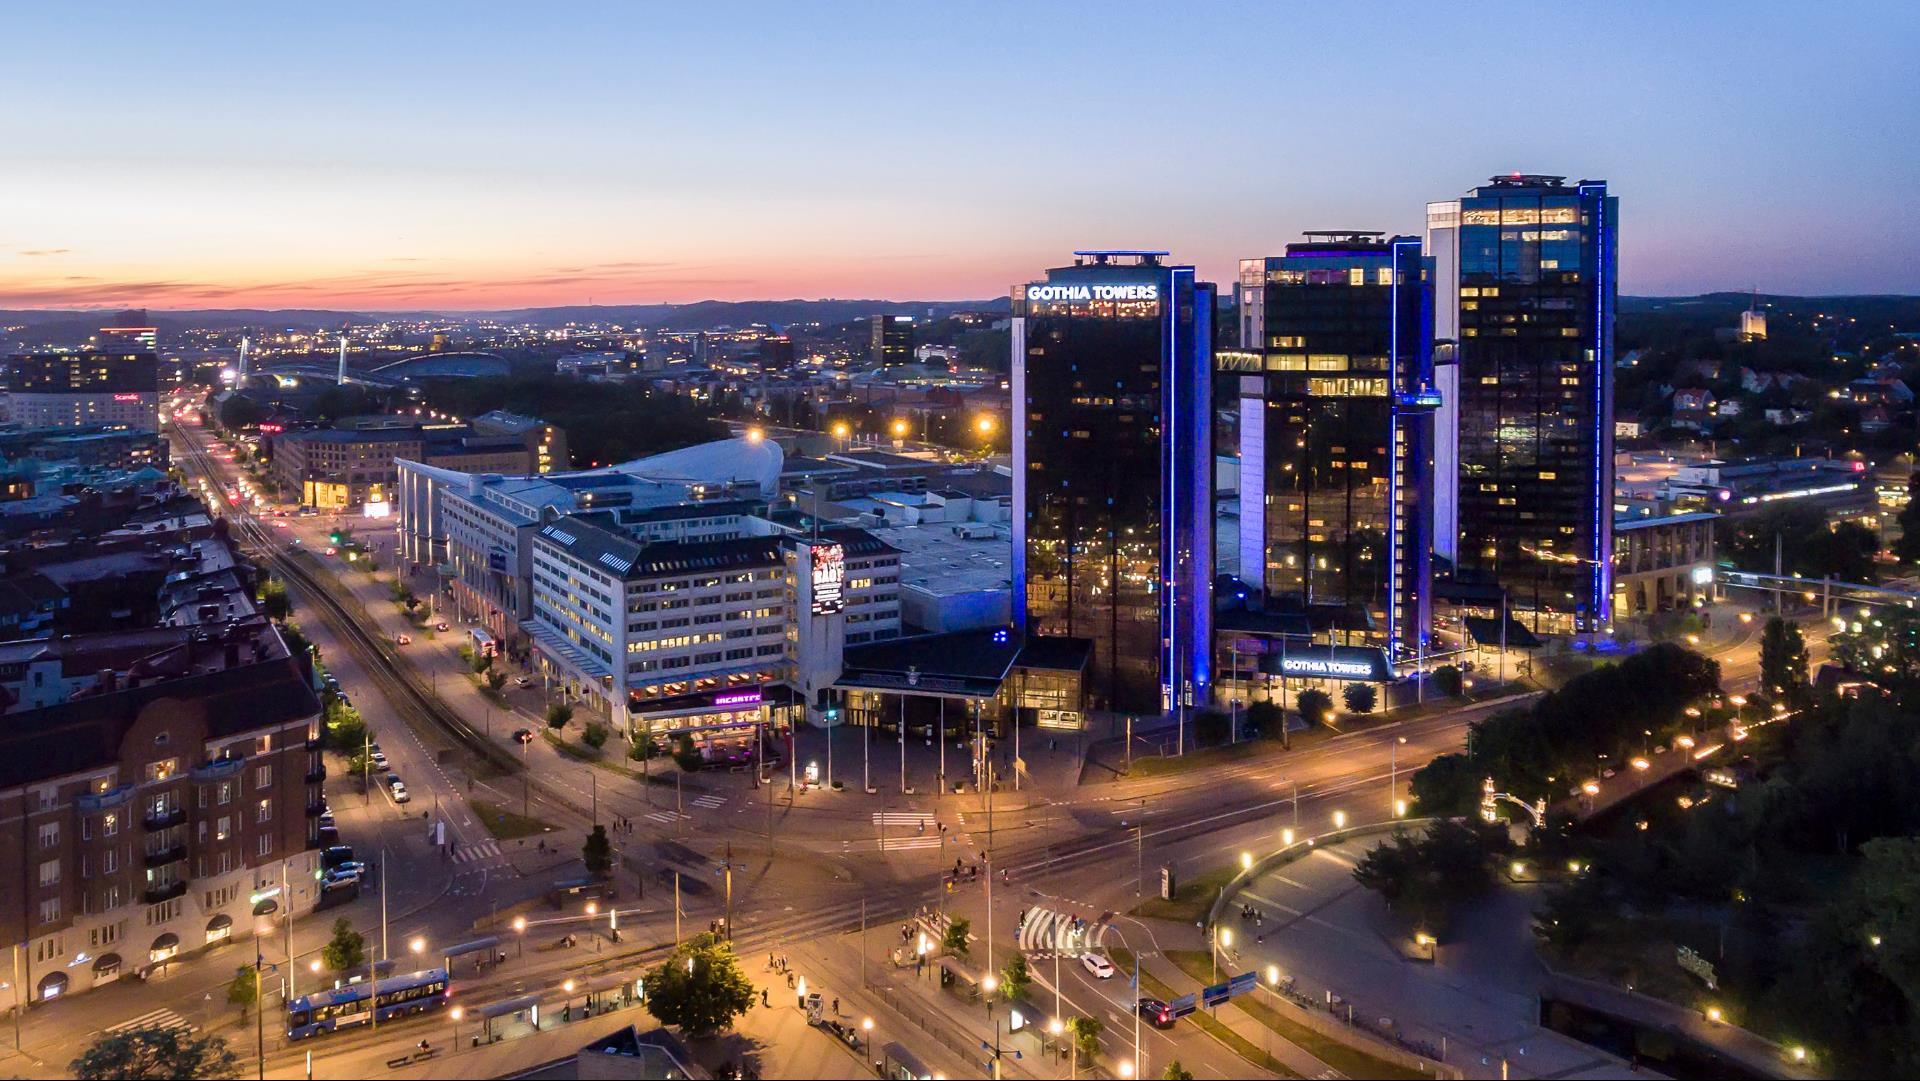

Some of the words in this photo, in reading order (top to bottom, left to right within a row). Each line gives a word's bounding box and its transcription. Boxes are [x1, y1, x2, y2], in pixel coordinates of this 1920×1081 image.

[1028, 286, 1091, 300] GOTHIA
[1093, 285, 1158, 300] TOWERS
[1284, 660, 1327, 672] GOTHIA
[1327, 662, 1372, 675] TOWERS
